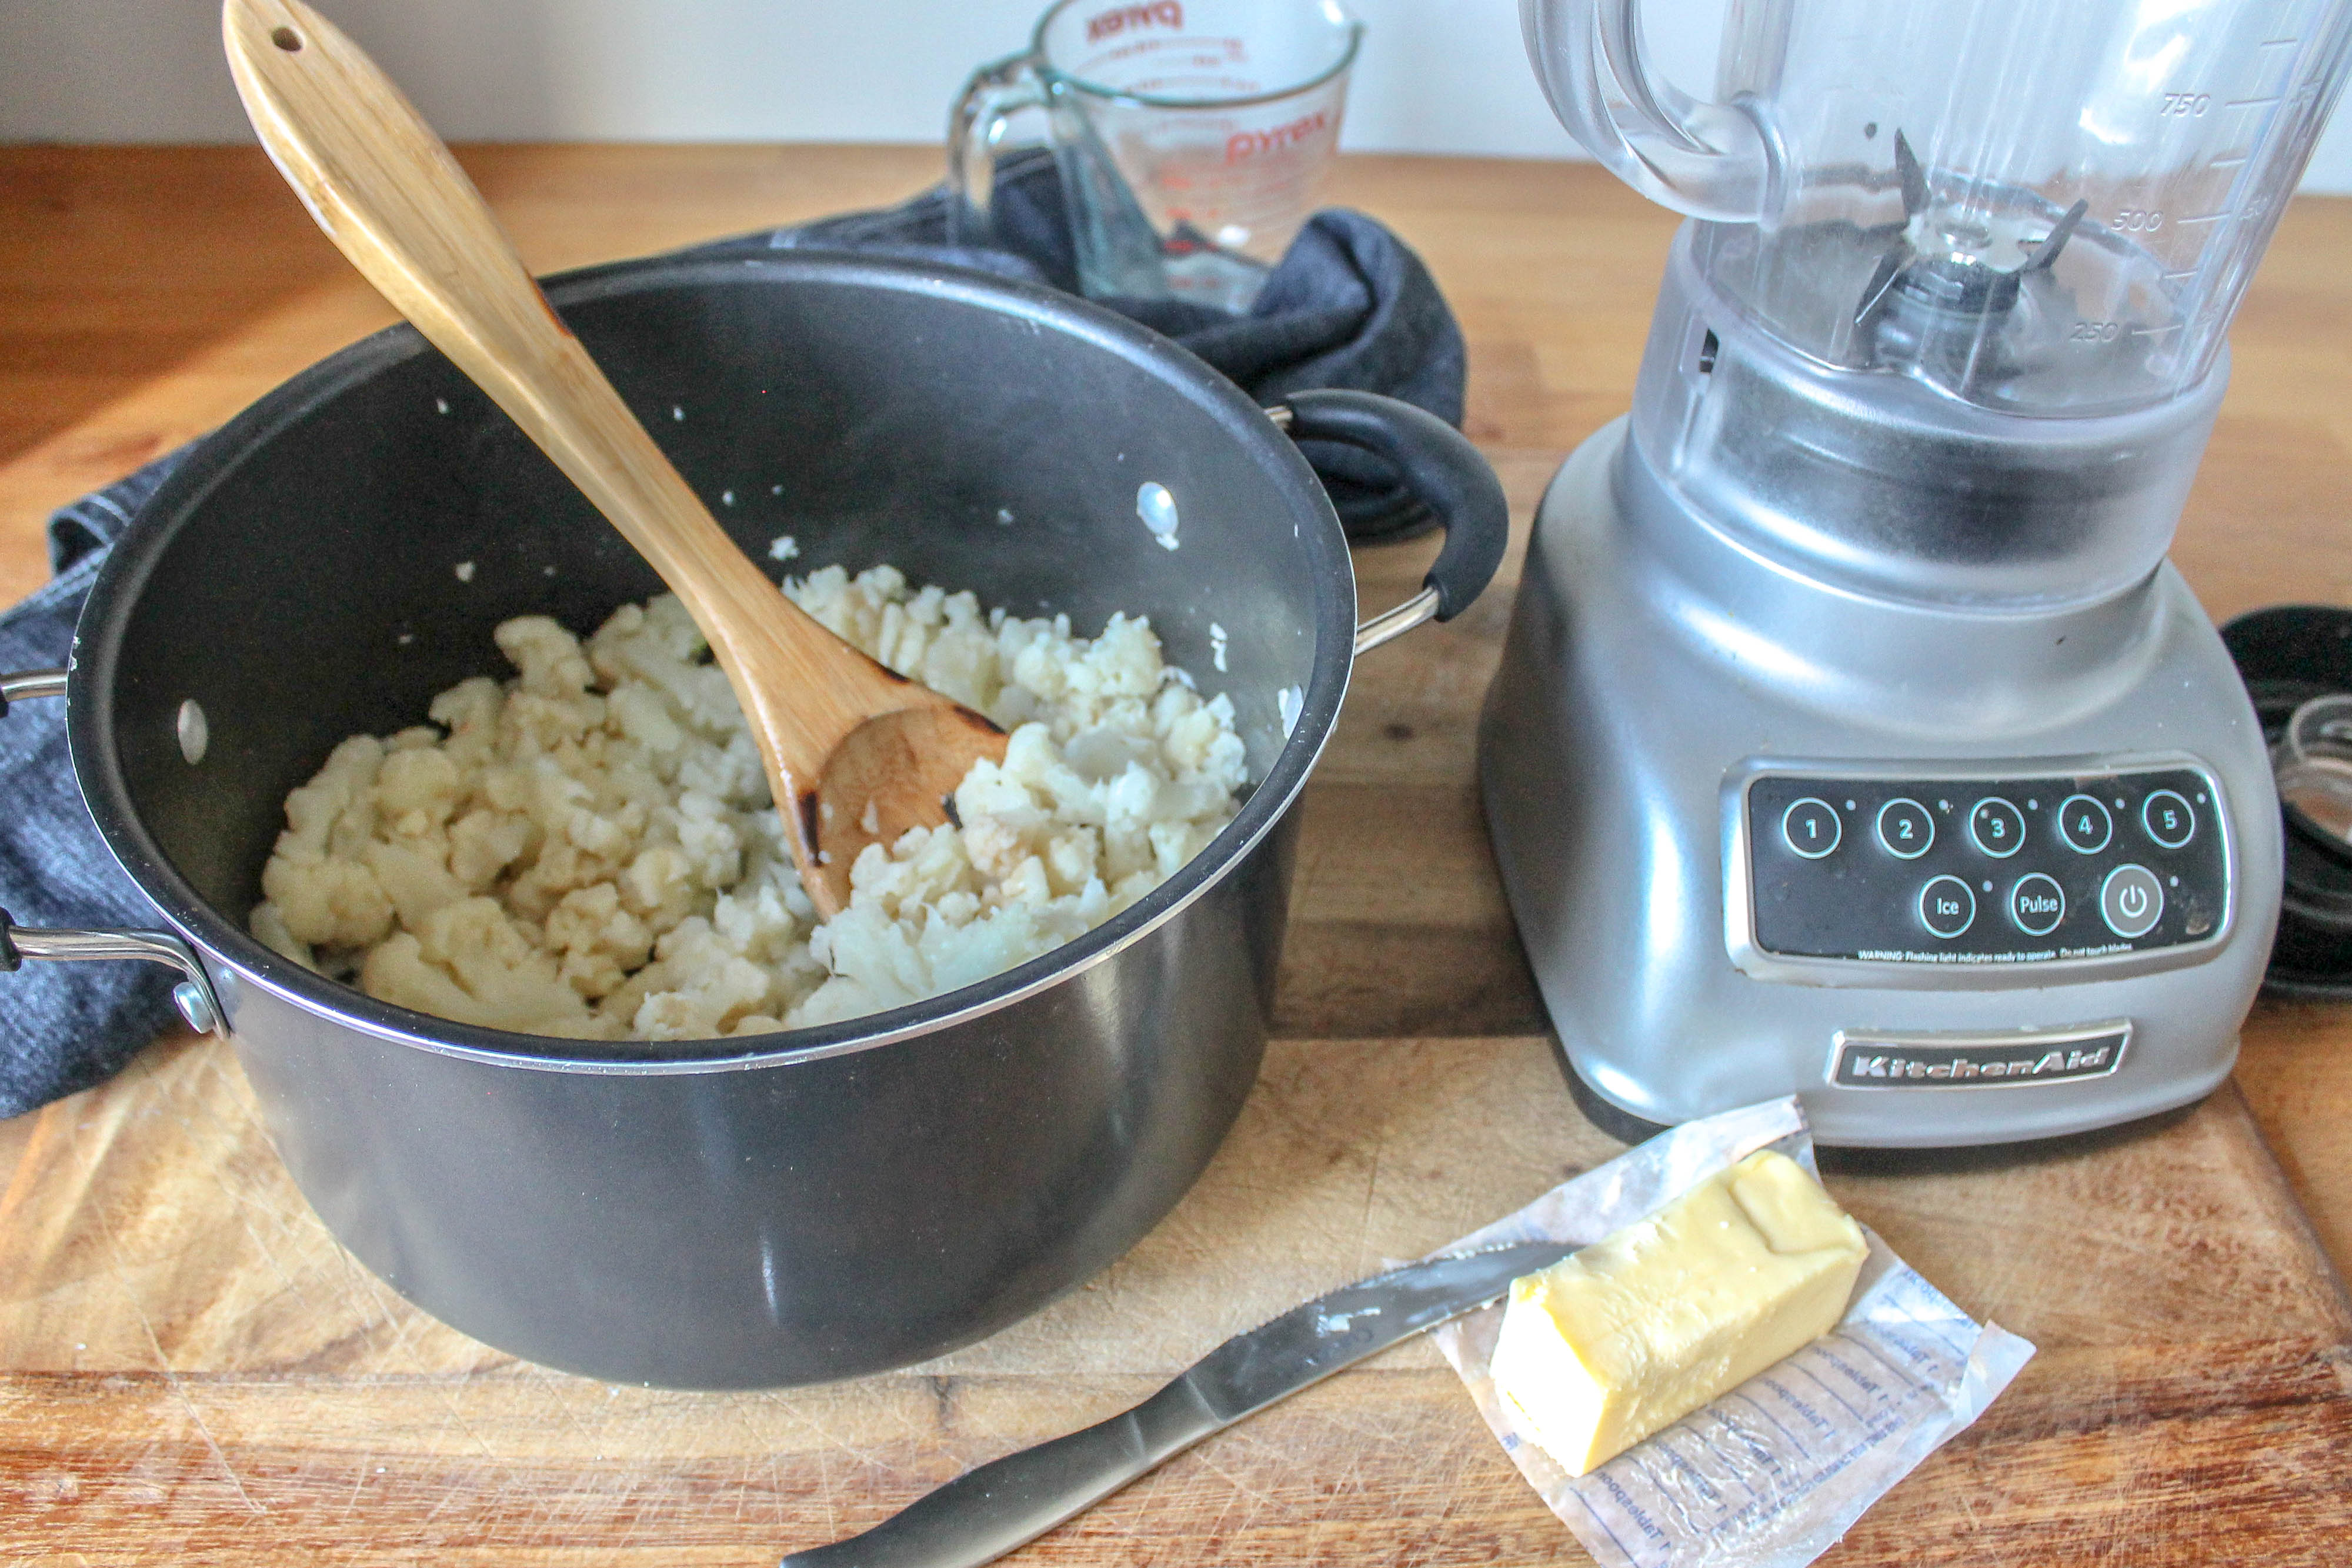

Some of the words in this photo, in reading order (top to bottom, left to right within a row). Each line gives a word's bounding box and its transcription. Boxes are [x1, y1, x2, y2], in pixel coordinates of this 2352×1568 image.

[2160, 93, 2210, 118] 750
[2110, 209, 2164, 232] 500
[2069, 322, 2117, 342] 250
[1806, 819, 1817, 839] 1
[1899, 819, 1913, 839] 2
[1991, 818, 2006, 838] 3
[2078, 815, 2093, 835] 4
[2163, 809, 2177, 830] 5
[1936, 898, 1960, 915] Ice
[2020, 895, 2059, 913] Pulse
[1853, 1046, 2111, 1078] KitchenAid
